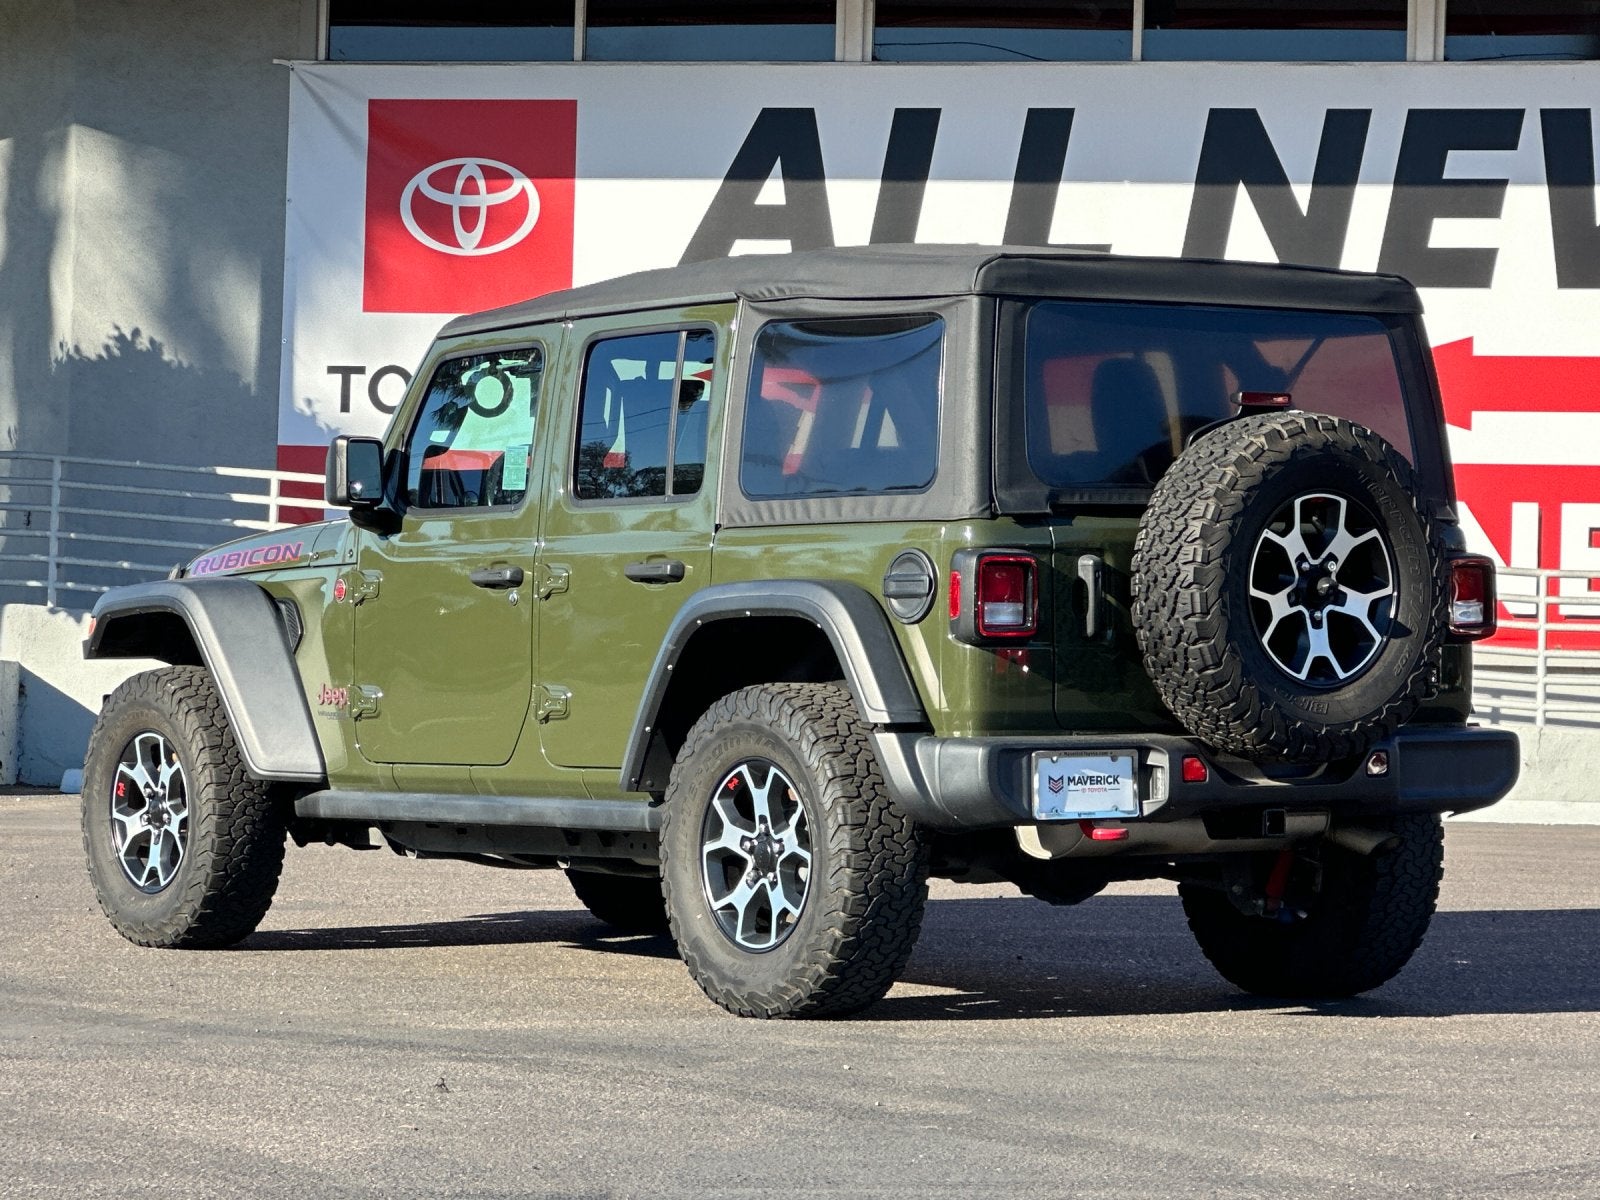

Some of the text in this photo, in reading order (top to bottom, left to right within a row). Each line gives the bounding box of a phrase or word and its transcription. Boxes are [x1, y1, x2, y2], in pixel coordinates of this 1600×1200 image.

[677, 107, 1113, 267] ALL
[191, 542, 304, 577] RUBICON
[317, 683, 348, 711] Jeep
[1067, 774, 1120, 786] MAVERICK
